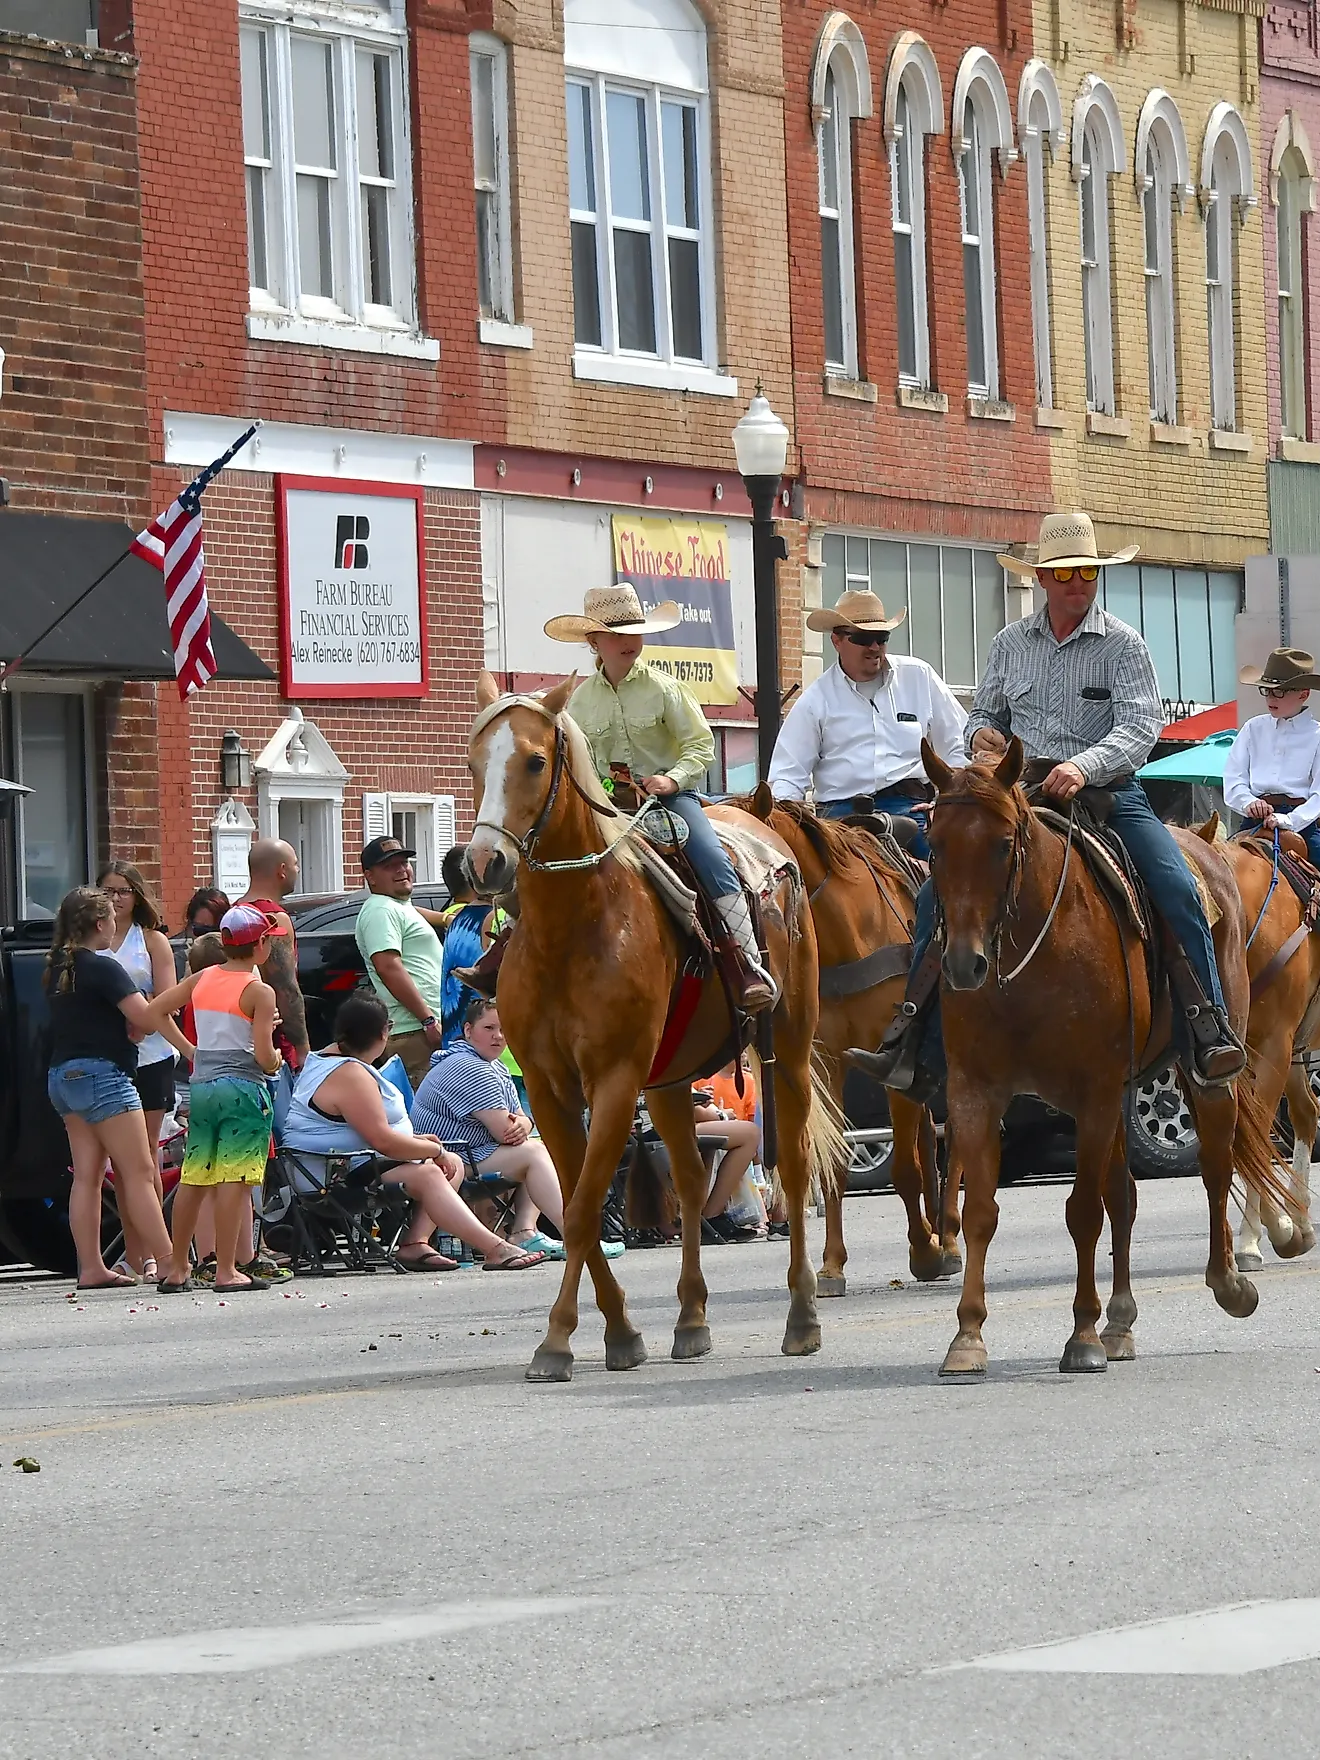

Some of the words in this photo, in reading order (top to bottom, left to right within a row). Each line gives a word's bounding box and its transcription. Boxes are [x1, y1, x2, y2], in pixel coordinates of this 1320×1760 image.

[620, 530, 683, 581] Chinese
[687, 535, 725, 584] Food
[316, 580, 347, 605] FARM
[350, 580, 393, 606] BUREAU
[300, 610, 358, 636] FINANCIAL
[361, 611, 409, 636] SERVICES
[699, 607, 712, 624] out
[291, 642, 310, 663] Alex
[313, 642, 352, 663] Reinecke
[357, 642, 379, 666] (620)
[381, 642, 420, 663] 767-6834
[675, 661, 713, 682] 767-7373
